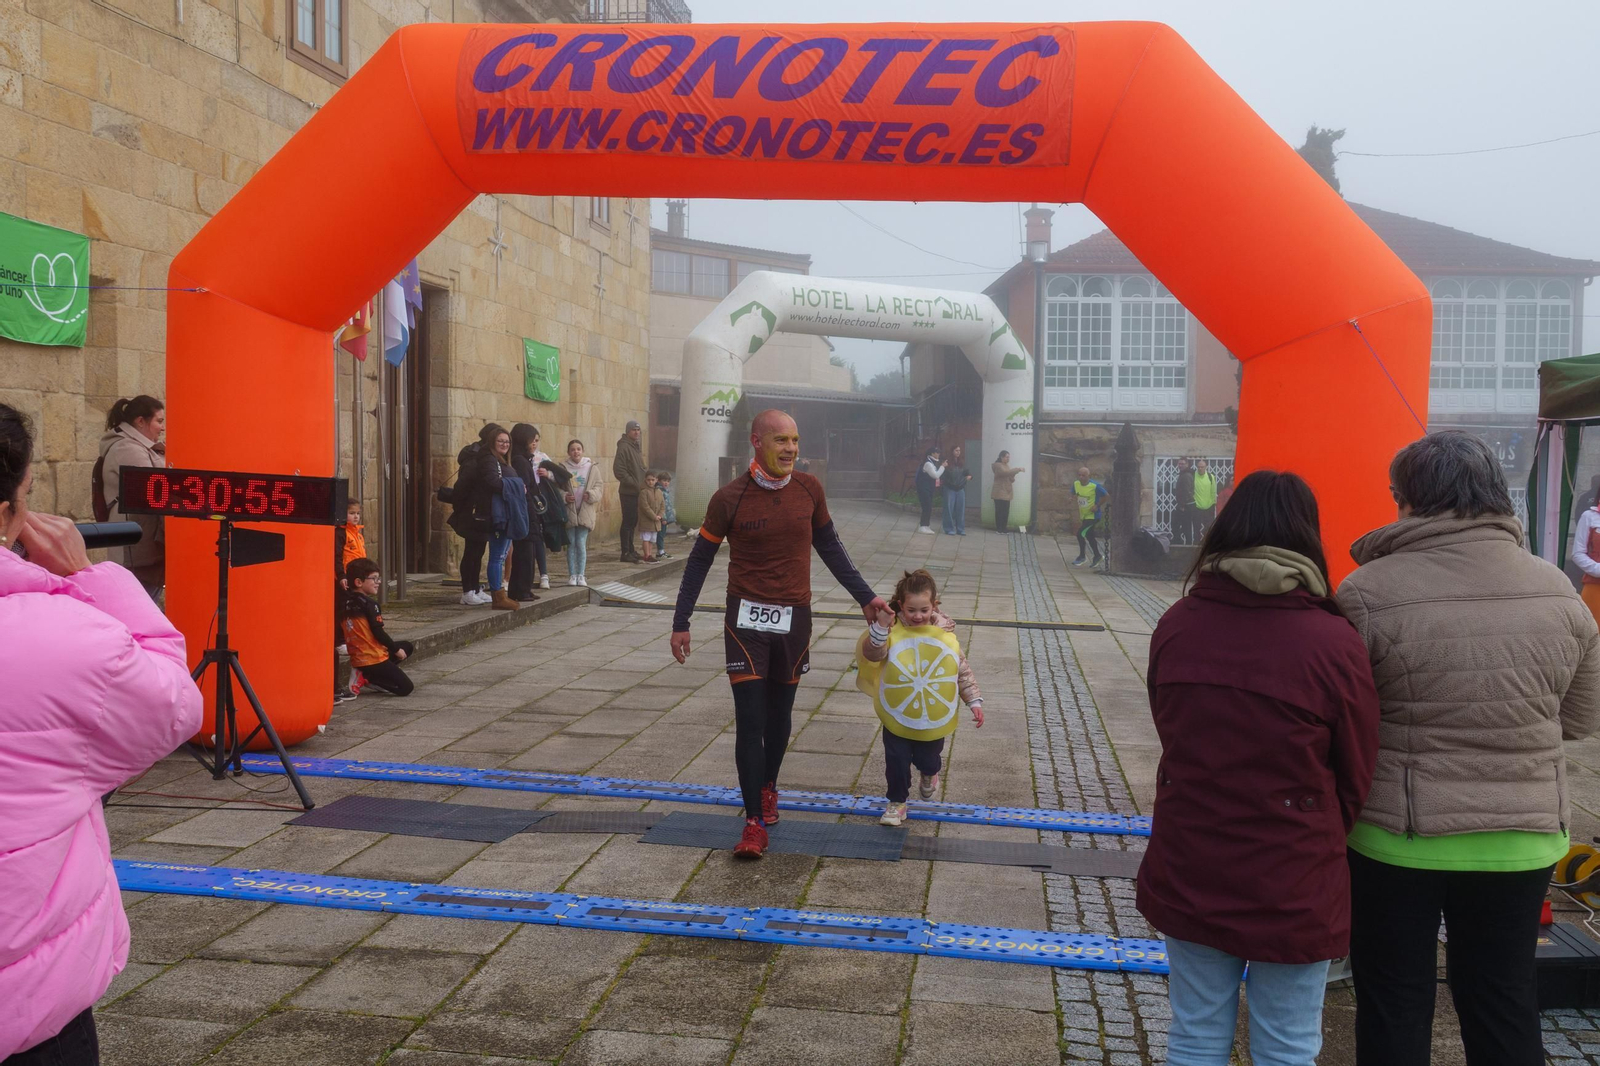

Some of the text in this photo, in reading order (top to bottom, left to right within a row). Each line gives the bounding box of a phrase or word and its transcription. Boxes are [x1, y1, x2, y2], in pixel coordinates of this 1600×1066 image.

[472, 32, 1059, 107] CRONOTEC
[472, 107, 1045, 165] WWW.CRONOTEC.ES
[792, 287, 854, 311] HOTEL
[865, 294, 887, 314] LA
[790, 311, 900, 330] www.hotelrectoral.com
[146, 474, 295, 516] 0:30:55
[749, 606, 781, 624] 550
[996, 813, 1120, 825] CRONOTEC
[234, 879, 387, 899] CRONOTEC
[452, 888, 533, 898] CRONOTEC
[623, 901, 705, 911] CRONOTEC
[797, 913, 882, 924] CRONOTEC
[936, 935, 1104, 956] CRONOTEC
